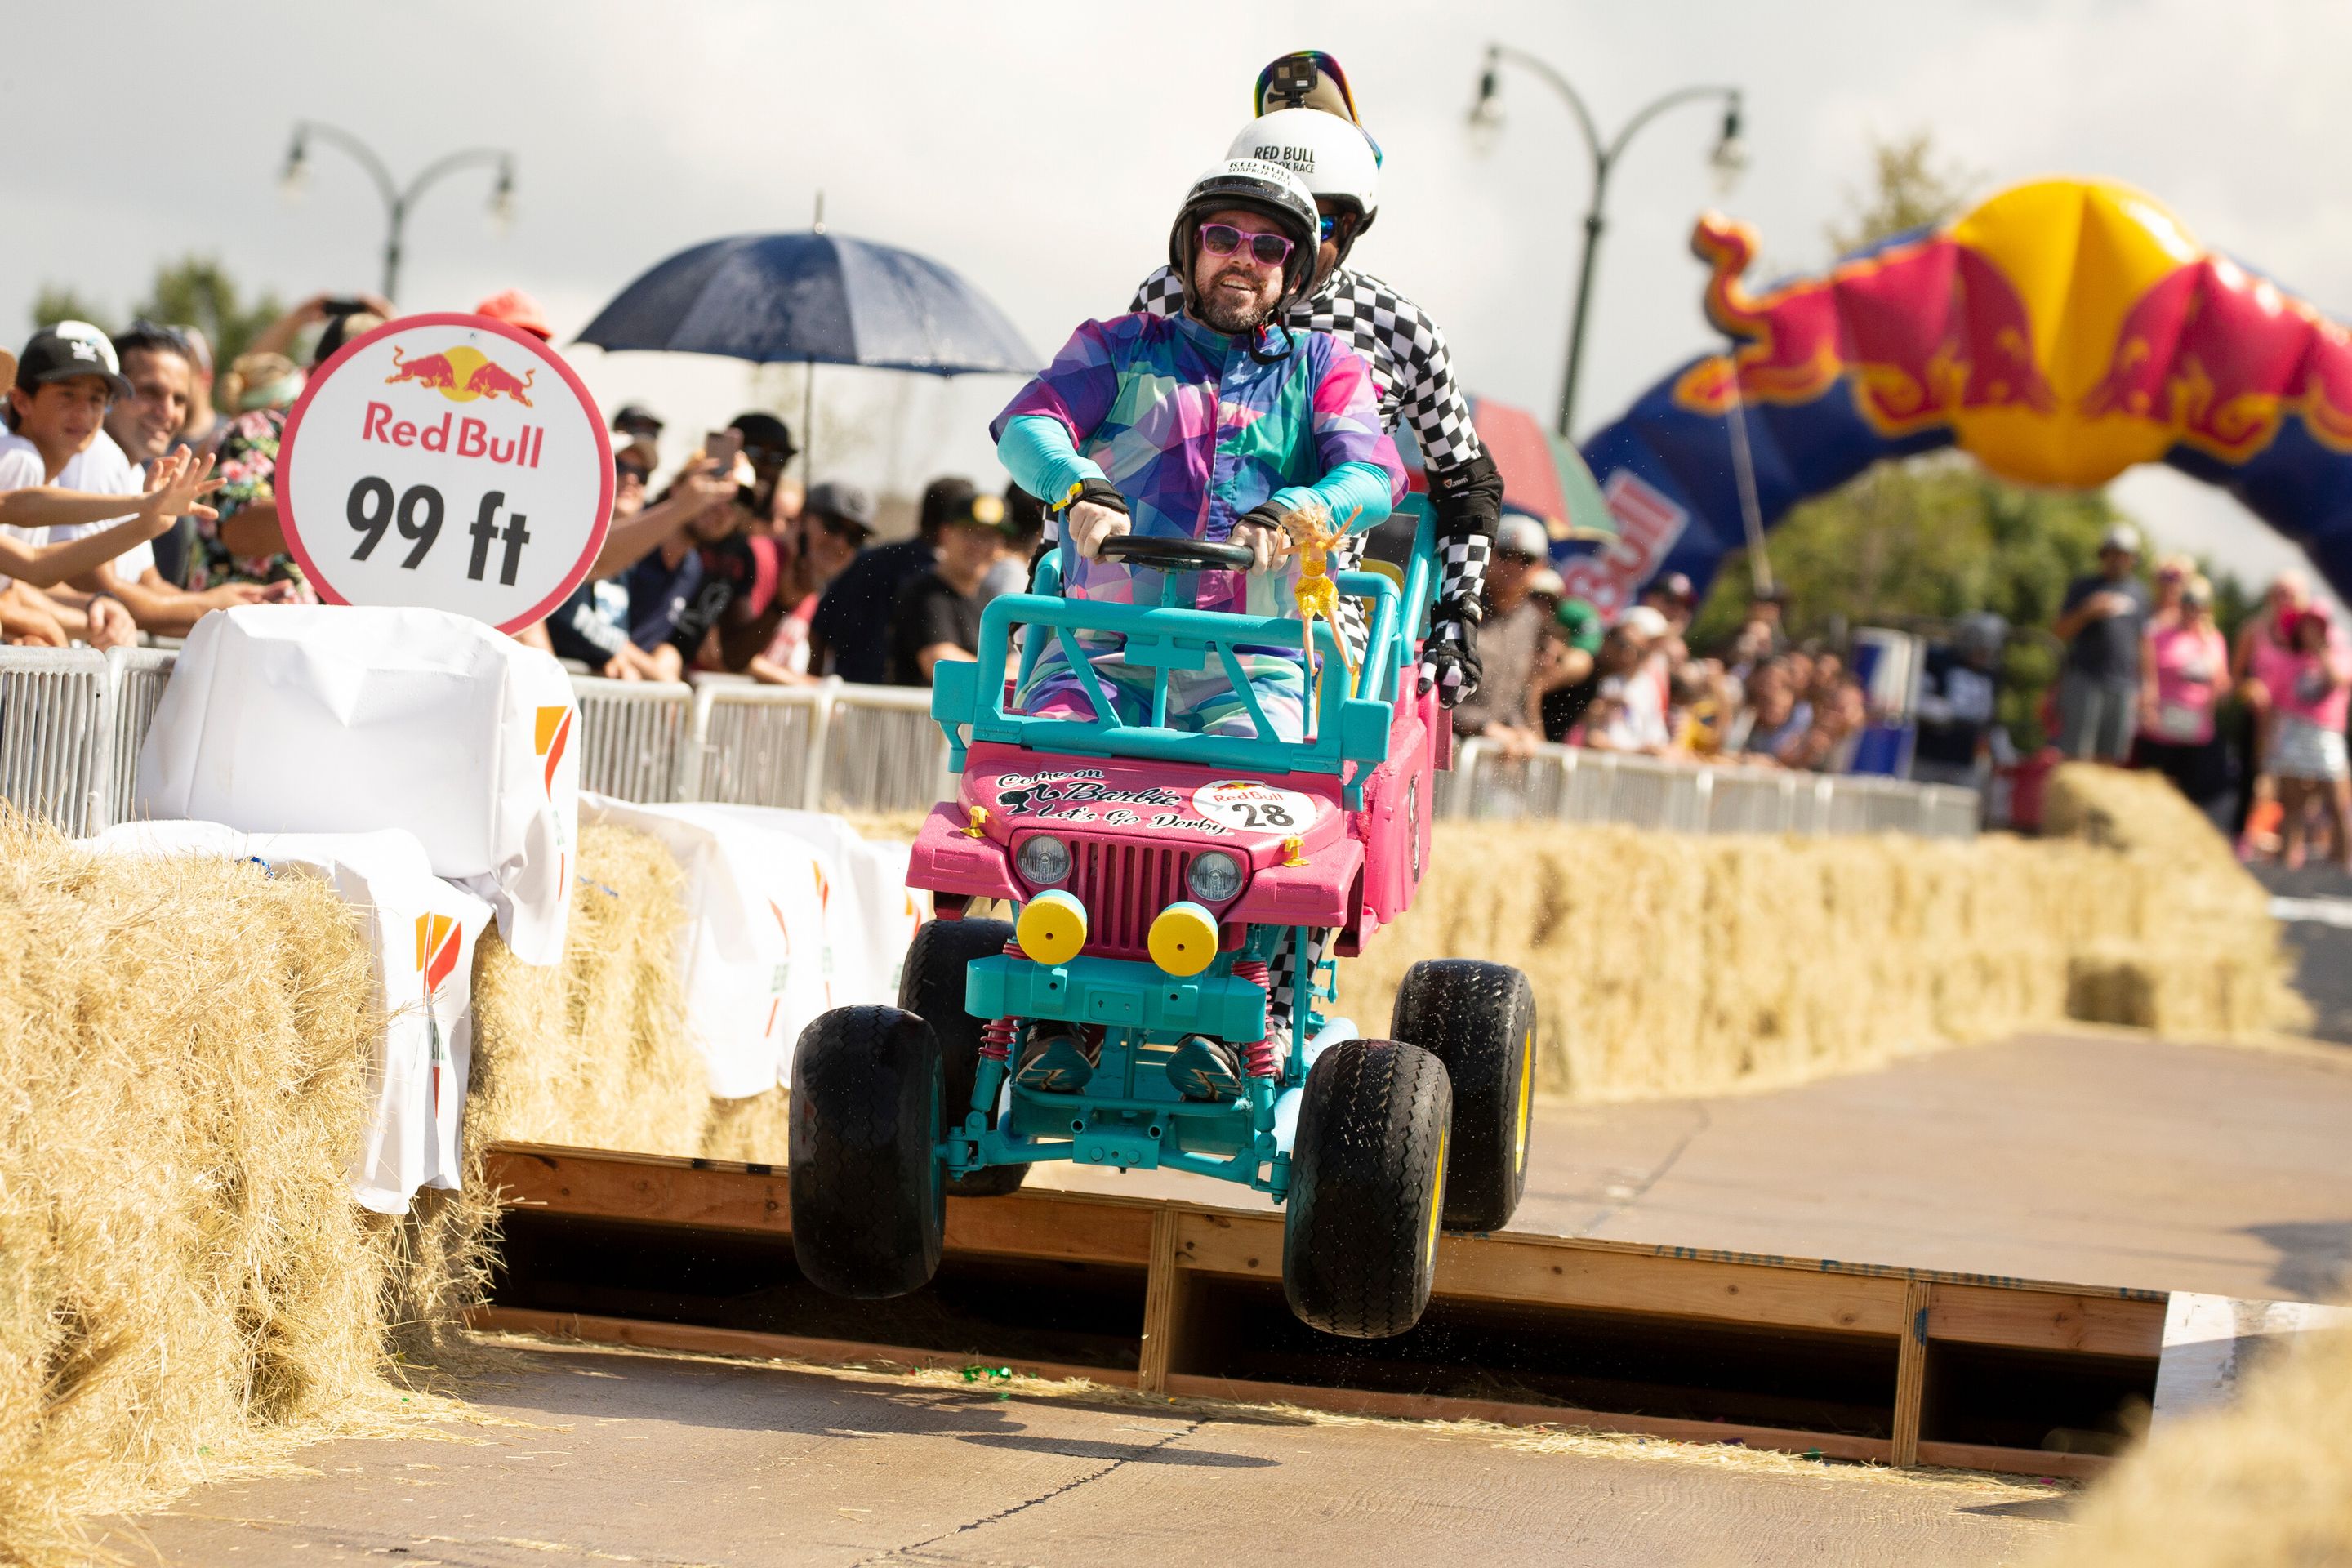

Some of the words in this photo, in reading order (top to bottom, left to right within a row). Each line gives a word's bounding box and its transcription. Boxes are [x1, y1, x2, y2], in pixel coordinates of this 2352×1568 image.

[1254, 146, 1279, 160] RED
[1284, 146, 1315, 163] BULL
[1228, 167, 1267, 176] SOAPBOX
[1293, 163, 1315, 174] RACE
[363, 401, 452, 452] Red
[457, 417, 544, 468] Bull
[346, 476, 444, 569] 99
[467, 490, 530, 586] ft
[997, 771, 1068, 787] Come
[1073, 769, 1102, 778] on
[1062, 782, 1181, 806] Barbie
[1213, 791, 1249, 802] Red
[1250, 791, 1284, 800] Bull
[1038, 804, 1097, 820] Let's
[1105, 809, 1139, 826] Go
[1149, 814, 1228, 835] Derby
[1232, 803, 1294, 827] 28
